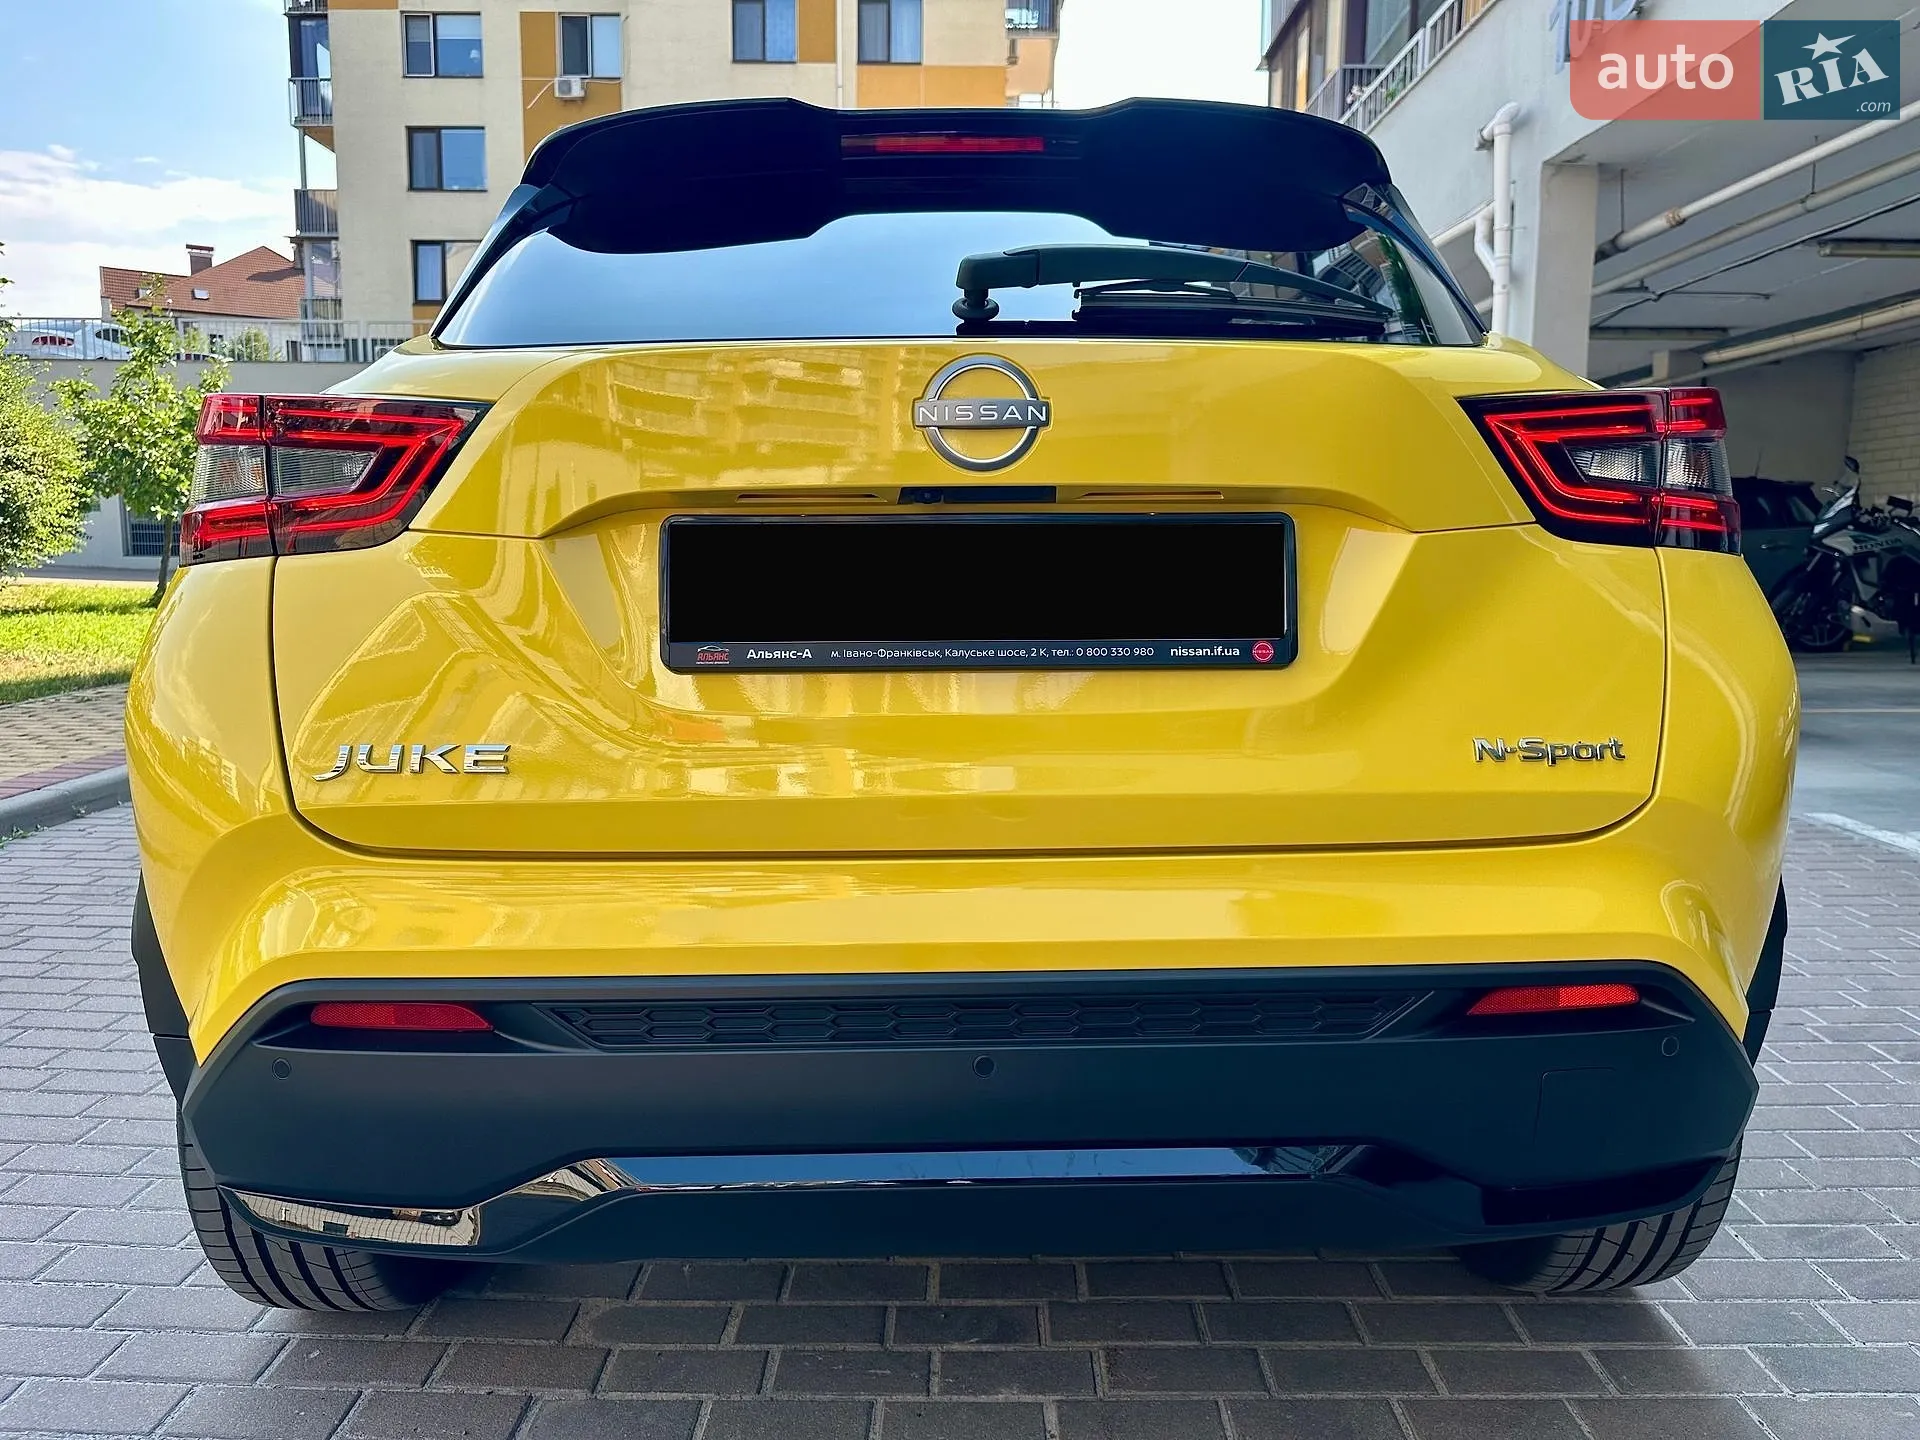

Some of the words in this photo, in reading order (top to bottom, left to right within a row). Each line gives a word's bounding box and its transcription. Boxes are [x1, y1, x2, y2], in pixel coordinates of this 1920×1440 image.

[919, 405, 1047, 422] NISSAN
[746, 648, 813, 659] Альянс-А
[830, 650, 841, 658] м.
[843, 648, 943, 660] Івано-Франківськ,
[944, 648, 995, 660] Калуське
[997, 649, 1029, 659] шосе,
[1030, 647, 1037, 657] 2
[1050, 649, 1074, 657] тел.:
[1075, 647, 1084, 657] 0
[1086, 647, 1108, 657] 800
[1110, 647, 1131, 657] 330
[1133, 647, 1155, 657] 980
[1170, 646, 1240, 657] nissan.if.ua
[1473, 737, 1626, 767] N-Sport
[311, 744, 511, 781] JUKE
